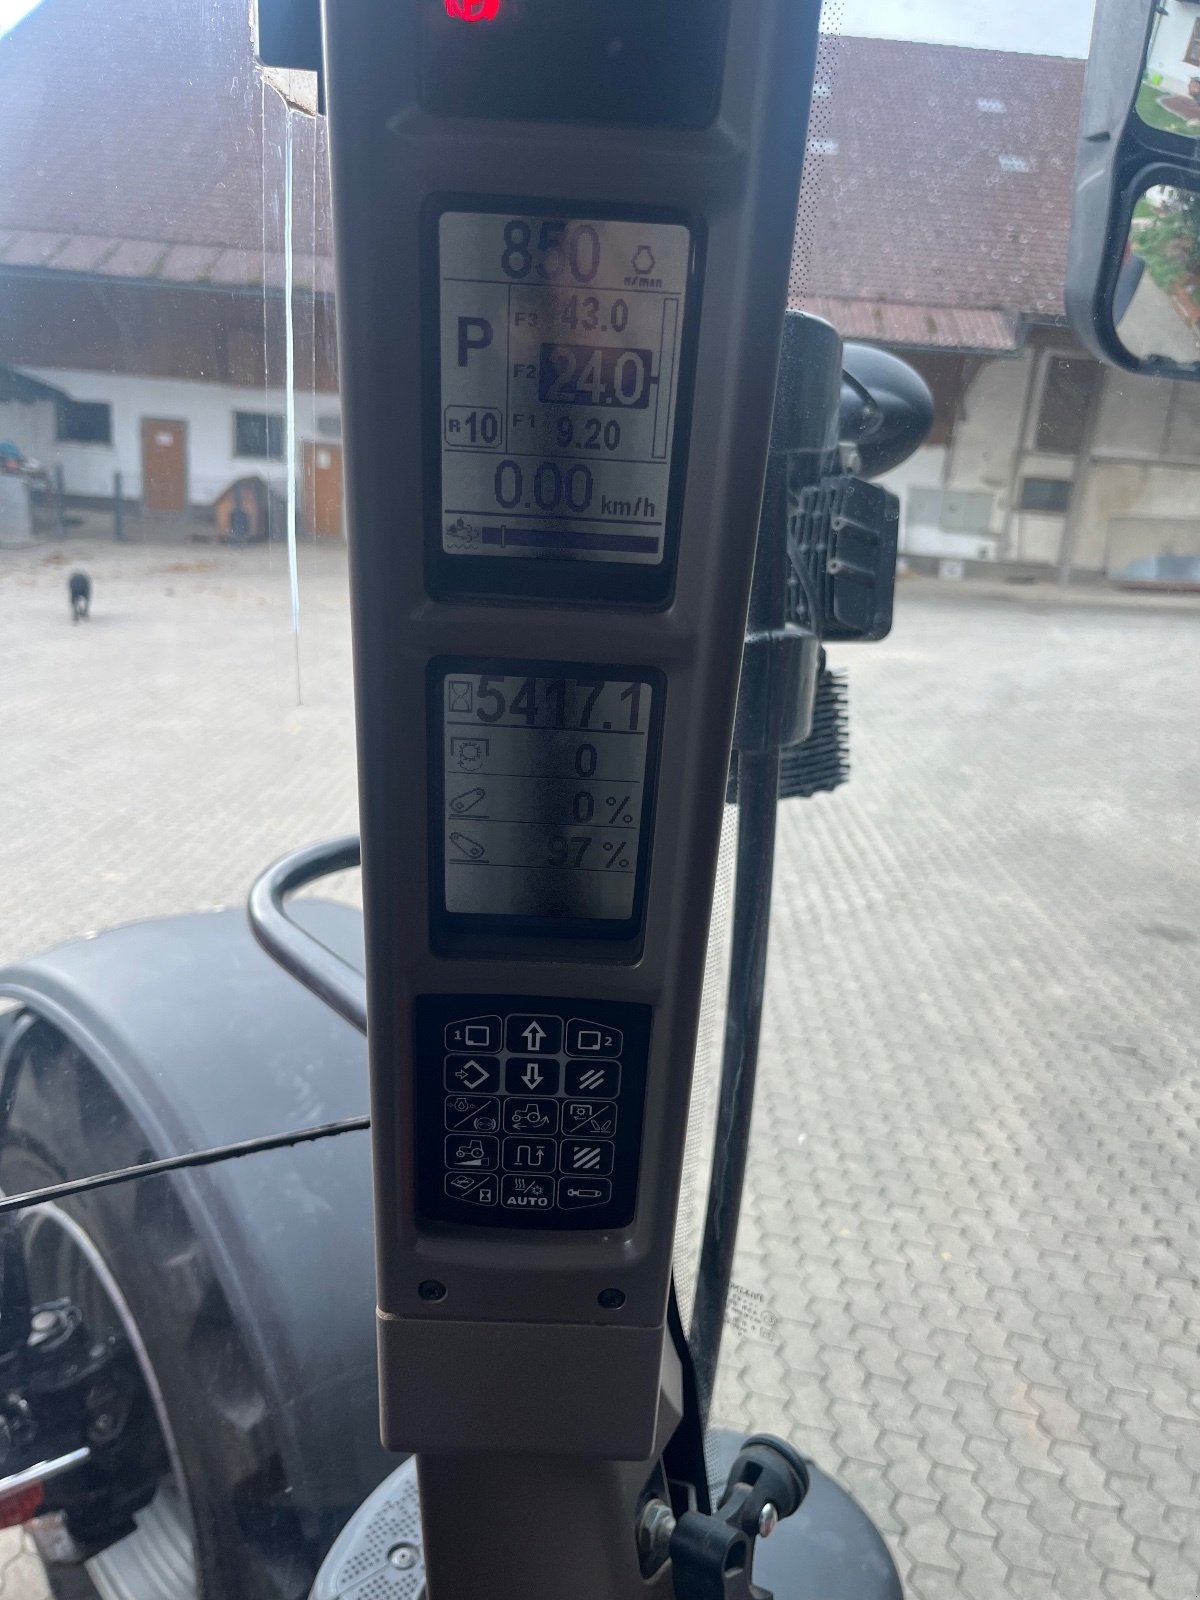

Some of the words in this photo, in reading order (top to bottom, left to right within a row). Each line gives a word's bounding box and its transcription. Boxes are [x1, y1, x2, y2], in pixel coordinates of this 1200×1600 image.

[502, 220, 601, 283] 850
[514, 312, 538, 328] F3
[561, 297, 629, 333] 43.0
[457, 316, 493, 367] P
[513, 364, 537, 379] F2
[546, 349, 645, 405] 24.0
[512, 414, 536, 428] F1
[556, 416, 621, 450] 9.20
[494, 459, 594, 513] 0.00
[601, 495, 655, 518] km/h
[476, 674, 641, 731] 5417.1
[574, 743, 598, 778] 0
[572, 791, 595, 824] 0
[549, 834, 593, 869] 97
[454, 1030, 462, 1040] 1
[604, 1036, 613, 1046] 2
[506, 1196, 548, 1206] AUTO
